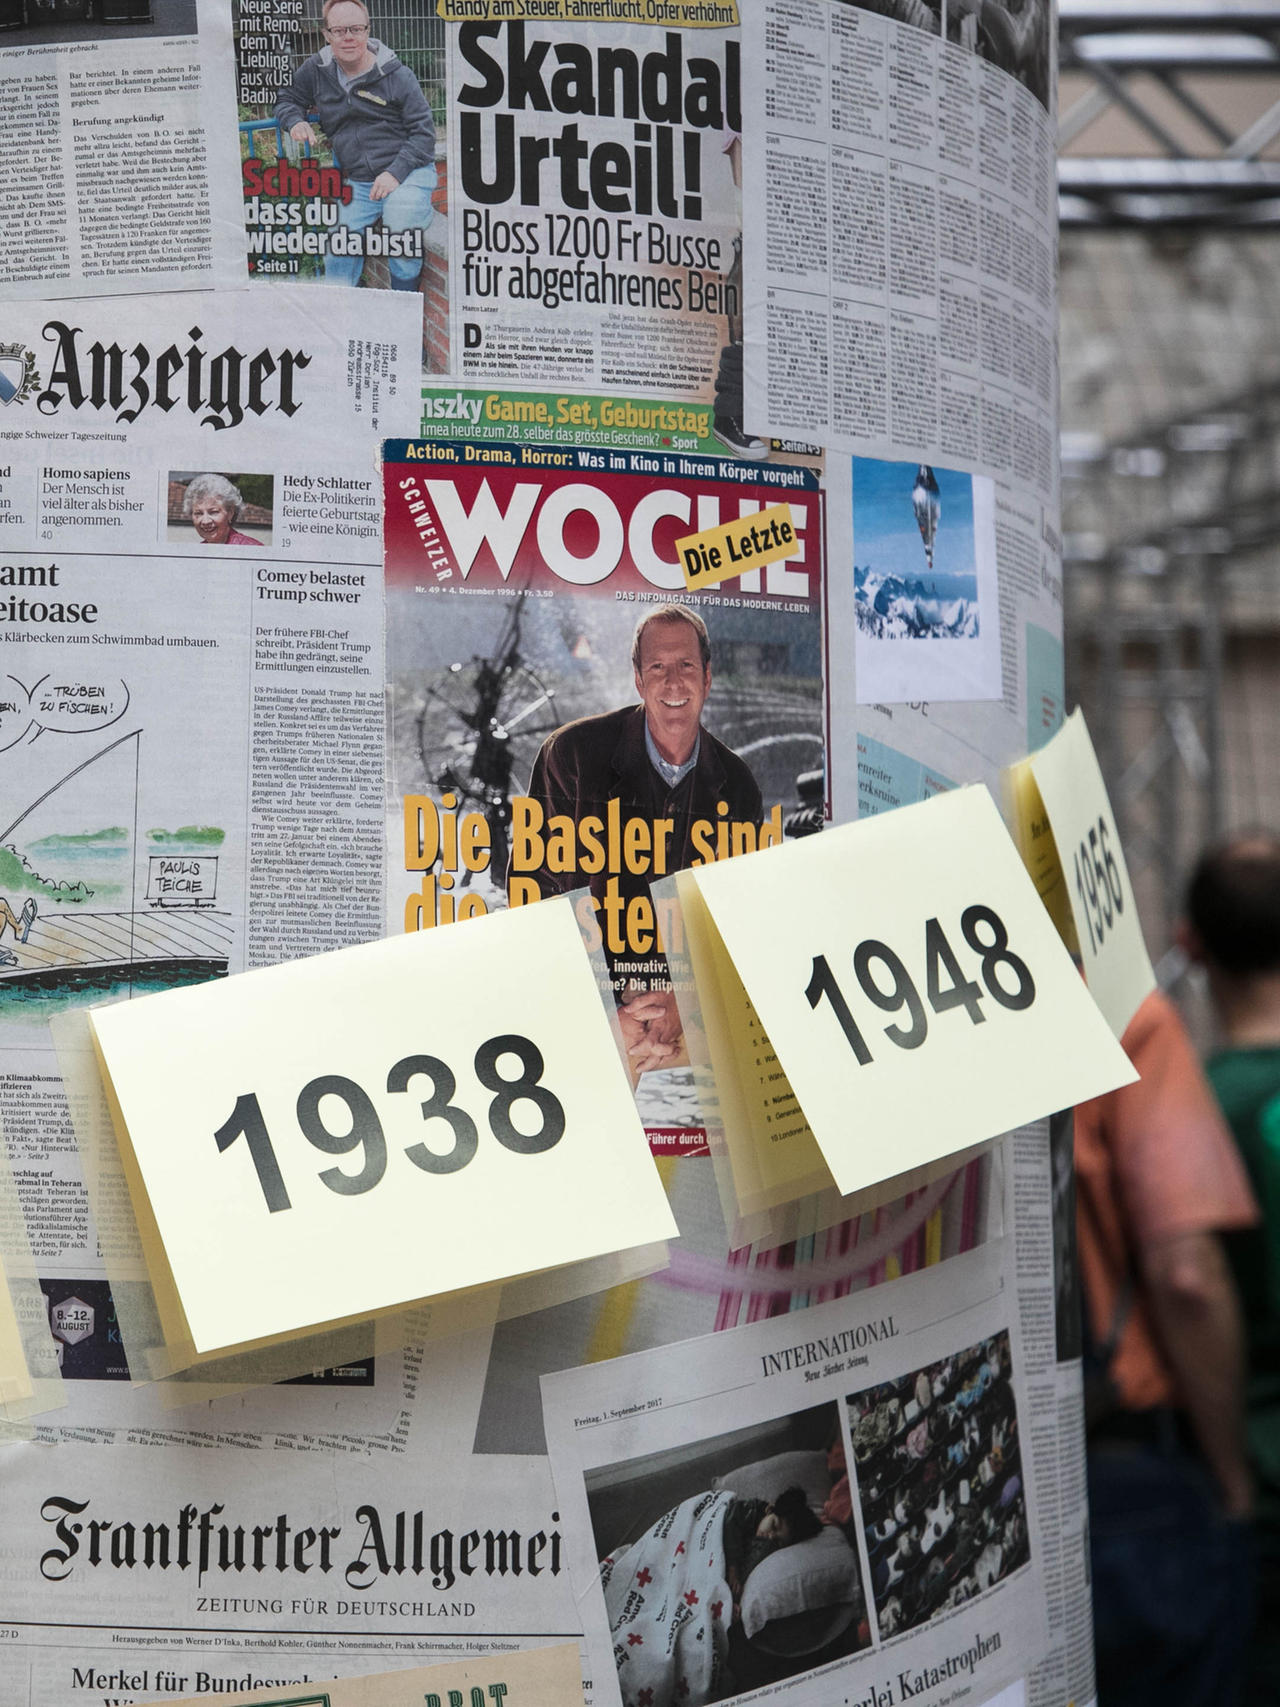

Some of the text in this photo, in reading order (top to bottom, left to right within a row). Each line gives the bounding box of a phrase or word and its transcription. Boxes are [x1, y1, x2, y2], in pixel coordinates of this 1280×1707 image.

[240, 0, 302, 14] Neue Serie
[445, 0, 734, 23] Handy am Steuer, Fahrerflucht, Opfer verhöhnt
[240, 18, 302, 35] mit Remo,
[240, 34, 290, 49] dem TV-
[241, 52, 289, 70] Liebling
[241, 68, 292, 86] aus «Üsi
[457, 20, 742, 132] Skandal
[241, 88, 277, 104] Badi»
[460, 112, 702, 221] Urteil!
[244, 159, 352, 205] Schön,
[244, 197, 336, 225] dass du
[248, 226, 423, 257] wieder da bist!
[463, 209, 720, 271] Bloss 1200 Fr Busse
[257, 260, 298, 272] Seite 11
[463, 253, 738, 316] für abgefahrenes Bein
[38, 320, 312, 431] Anzeiger
[421, 393, 710, 438] nszky Game, Set, Geburtstag
[25, 430, 69, 441] Schweizer
[72, 430, 127, 443] Tageszeitung
[451, 423, 480, 439] heute
[483, 426, 505, 439] zum
[507, 425, 522, 440] 28.
[524, 425, 553, 442] selber
[556, 427, 574, 442] das
[575, 429, 610, 447] grösste
[611, 430, 660, 447] Geschenk?
[673, 437, 698, 451] Sport
[43, 468, 130, 483] Homo sapiens
[406, 443, 804, 487] Action, Drama, Horror: Was im Kino in Ihrem Körper vorgeht
[43, 483, 124, 495] Der Mensch ist
[284, 476, 372, 491] Hedy Schlatter
[42, 499, 144, 512] viel älter als bisher
[41, 515, 123, 528] angenommen.
[399, 476, 453, 581] SCHWEIZER
[684, 518, 793, 577] Die Letzte
[257, 569, 365, 586] Comey belastet
[257, 587, 360, 603] Trump schwer
[404, 793, 783, 875] Die Basler sind
[1072, 815, 1124, 958] 1956
[804, 903, 1037, 1068] 1948
[214, 1034, 566, 1214] 1938
[57, 1322, 90, 1331] AUGUST
[761, 1316, 899, 1377] INTERNATIONAL
[39, 1496, 561, 1591] Frankfurter Allgemei
[196, 1598, 476, 1617] ZEITUNG FÜR DEUTSCHLAND
[71, 1668, 188, 1693] Merkel für
[897, 1632, 1001, 1701] Katastrophen
